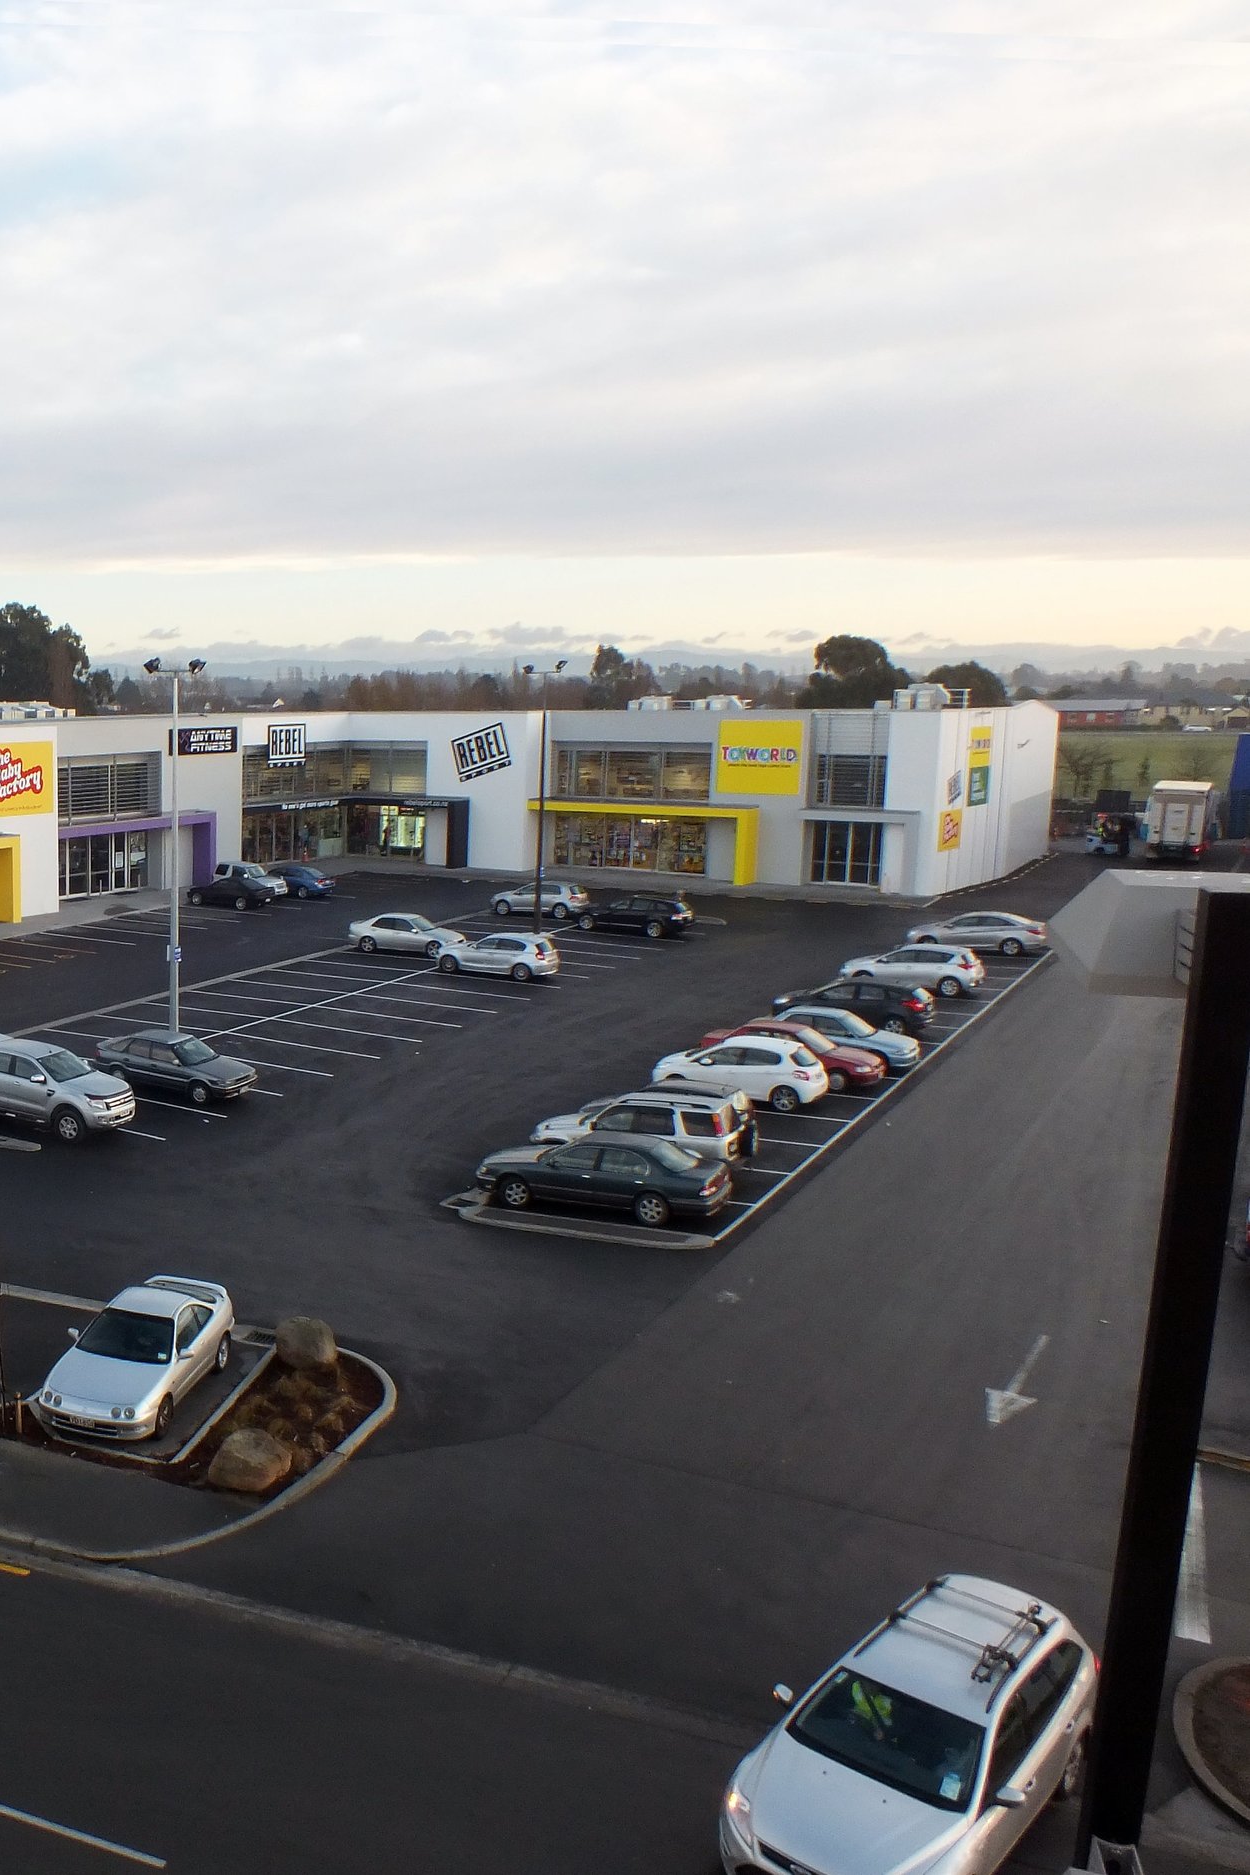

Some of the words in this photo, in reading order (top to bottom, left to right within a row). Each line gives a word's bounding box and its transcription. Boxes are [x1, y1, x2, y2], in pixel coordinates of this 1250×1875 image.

[190, 729, 232, 741] ANYTIME
[271, 728, 303, 756] REBEL
[190, 741, 232, 753] FITNESS
[456, 730, 505, 769] REBEL
[722, 746, 797, 762] TOYWORLD
